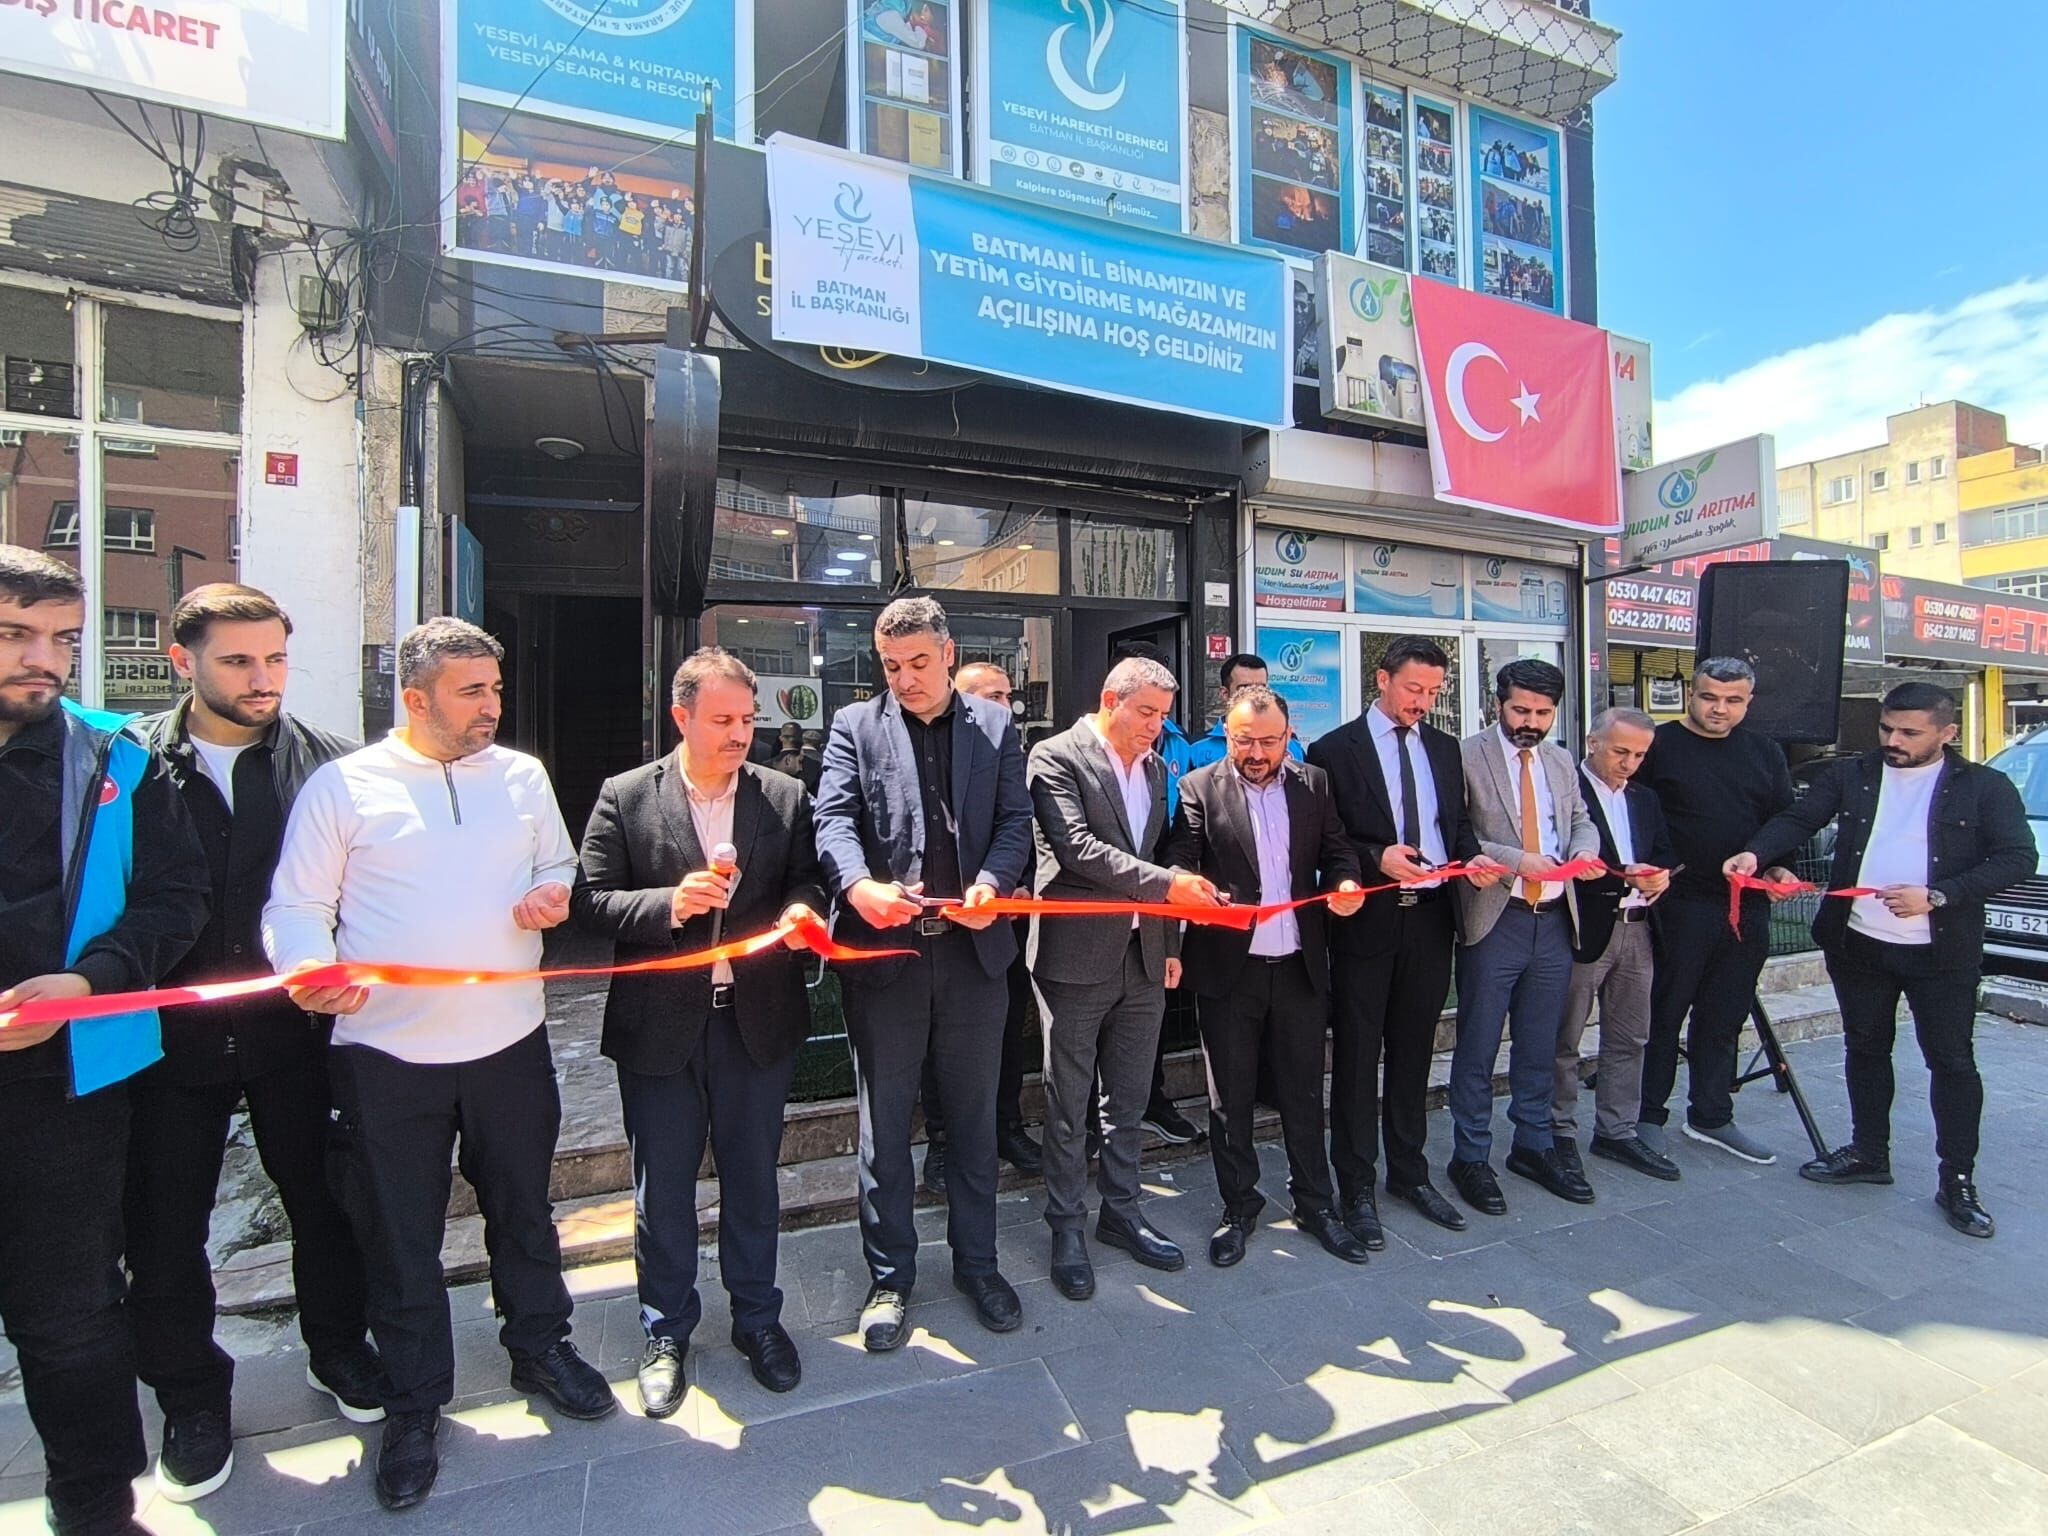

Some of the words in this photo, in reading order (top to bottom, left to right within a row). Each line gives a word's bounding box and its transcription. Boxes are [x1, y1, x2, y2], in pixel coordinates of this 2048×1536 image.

[473, 22, 538, 49] YESEVİ
[542, 39, 608, 65] ARAMA
[613, 55, 624, 68] &
[629, 59, 722, 90] KURTARMA
[486, 44, 550, 68] YESEVİ
[555, 61, 625, 85] SEARCH
[630, 76, 641, 88] &
[1002, 101, 1048, 121] YESEVİ
[1051, 114, 1113, 138] HAREKETİ
[1116, 130, 1169, 153] DERNEĞİ
[1029, 123, 1073, 142] BATMAN
[1016, 179, 1056, 196] Kalplere
[1113, 200, 1159, 219] üşümüz...
[972, 232, 1075, 273] BATMAN
[1081, 251, 1101, 279] İL
[1106, 260, 1217, 302] BİNAMIZIN
[1221, 286, 1246, 311] VE
[817, 280, 886, 303] BATMAN
[930, 250, 1008, 286] YETİM
[1015, 271, 1132, 314] GİYDİRME
[1137, 299, 1276, 349] MAĞAZAMIZIN
[791, 291, 806, 308] İL
[811, 296, 909, 324] BAŞKANLIĞI
[978, 296, 1098, 340] AÇILIŞINA
[1104, 322, 1150, 356] HOŞ
[1155, 334, 1243, 373] GELDİNİZ
[278, 462, 285, 473] 6
[1624, 514, 1669, 540] YUDUM
[1675, 509, 1693, 525] SU
[1697, 492, 1755, 520] ARITMA
[1660, 529, 1703, 552] Yudumda
[1290, 568, 1302, 578] SU
[1304, 570, 1339, 580] ARITMA
[1265, 594, 1327, 609] Hoşgeldiniz
[1608, 581, 1638, 599] 0530
[1641, 586, 1663, 603] 447
[1665, 590, 1691, 606] 4621
[1608, 608, 1639, 628] 0542
[1641, 611, 1663, 629] 287
[1665, 614, 1692, 632] 1405
[1924, 600, 1943, 616] 0530
[1944, 603, 1959, 618] 447
[1844, 634, 1871, 649] KAMA
